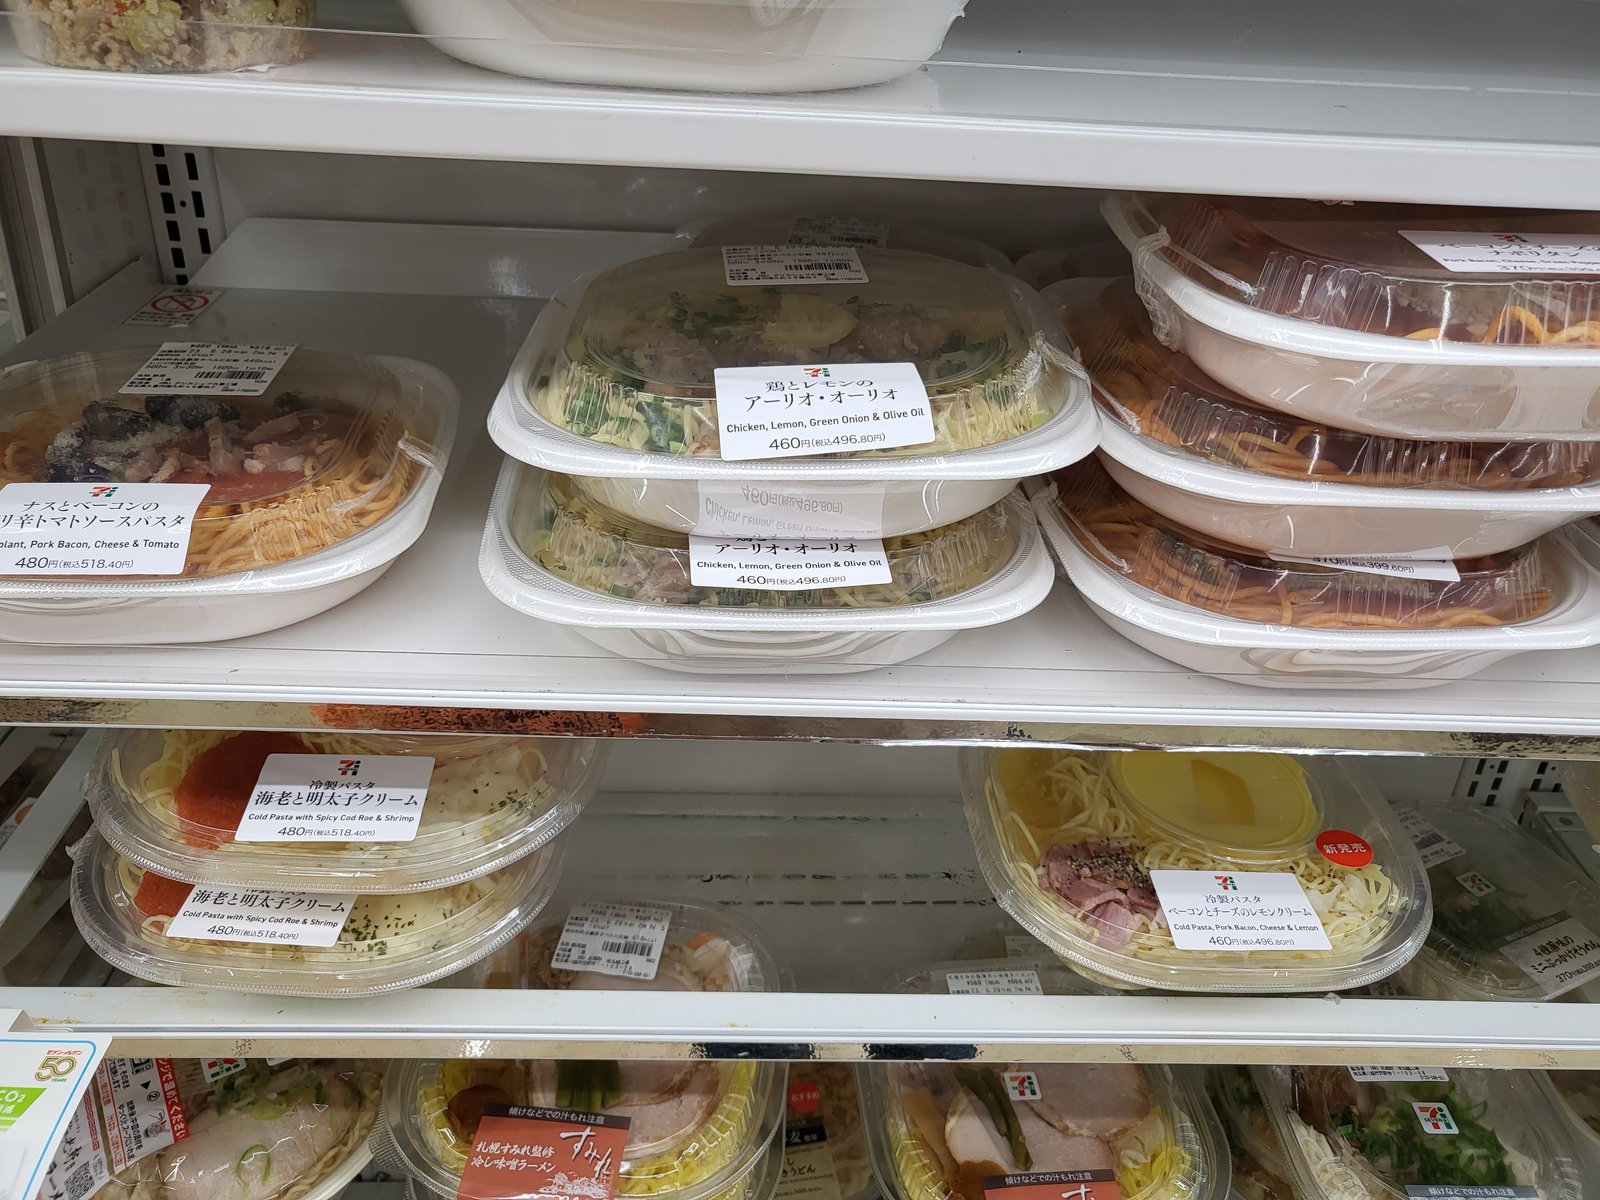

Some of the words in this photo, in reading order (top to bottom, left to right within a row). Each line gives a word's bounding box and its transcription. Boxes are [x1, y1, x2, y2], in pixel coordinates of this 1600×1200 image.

[764, 379, 874, 393] 鶏とレモンの
[744, 388, 899, 412] アーリオ・オーリオ
[726, 421, 769, 434] Chicken,
[770, 418, 807, 430] Lemon,
[809, 416, 839, 427] Green
[841, 413, 870, 425] Onion
[872, 412, 880, 421] &
[882, 409, 908, 420] Olive
[910, 407, 925, 417] Oil
[769, 431, 886, 451] 460円(税込496.80円)
[21, 500, 160, 512] ナスとベーコンの
[0, 513, 186, 529] リ辛トマトソースパスタ
[30, 540, 54, 549] Pork
[58, 540, 91, 549] Bacon,
[94, 539, 130, 549] Cheese
[132, 539, 140, 548] &
[143, 539, 180, 549] Tomato
[715, 542, 858, 555] アーリオ・オーリオ
[15, 556, 135, 569] 480円(税込518.40円)
[697, 561, 737, 569] Chicken,
[738, 562, 773, 570] Lemon,
[775, 562, 803, 570] Green
[805, 561, 832, 569] Onion
[843, 559, 867, 568] Olive
[869, 558, 882, 566] Oil
[736, 574, 846, 586] 460円(税込496.80円)
[309, 779, 376, 791] 冷製パスタ
[254, 791, 419, 807] 海老と明太子クリーム
[248, 813, 268, 821] Cold
[269, 813, 293, 821] Pasta
[295, 813, 313, 821] with
[315, 814, 338, 823] Spicy
[384, 815, 415, 823] Shrimp
[277, 826, 376, 837] 480円(税込518.40円)
[1322, 843, 1367, 854] 新発売
[192, 889, 346, 913] 海老と明太子クリーム
[1204, 894, 1262, 904] 冷製パスタ
[1168, 906, 1313, 918] ベーコンとチーズのレモンクリーム
[182, 910, 201, 918] Cold
[202, 911, 225, 920] Pasta
[226, 913, 243, 921] with
[245, 914, 267, 923] Spicy
[285, 917, 300, 925] Roe
[310, 918, 339, 928] Shrimp
[207, 924, 299, 940] 480円(税込518.40円)
[1173, 923, 1191, 931] Cold
[1191, 924, 1215, 932] Pasta,
[1234, 924, 1259, 932] Bacon,
[1208, 936, 1295, 946] 460円(税込496.80円)
[34, 1055, 77, 1082] 50
[508, 1106, 606, 1125] 傾けなどでの汁もれ注意
[475, 1140, 556, 1158] 札幌すみれ監修
[470, 1154, 557, 1174] 冷し味噌ラーメン
[1004, 1171, 1093, 1186] 傾けなどでの汁もれ注意
